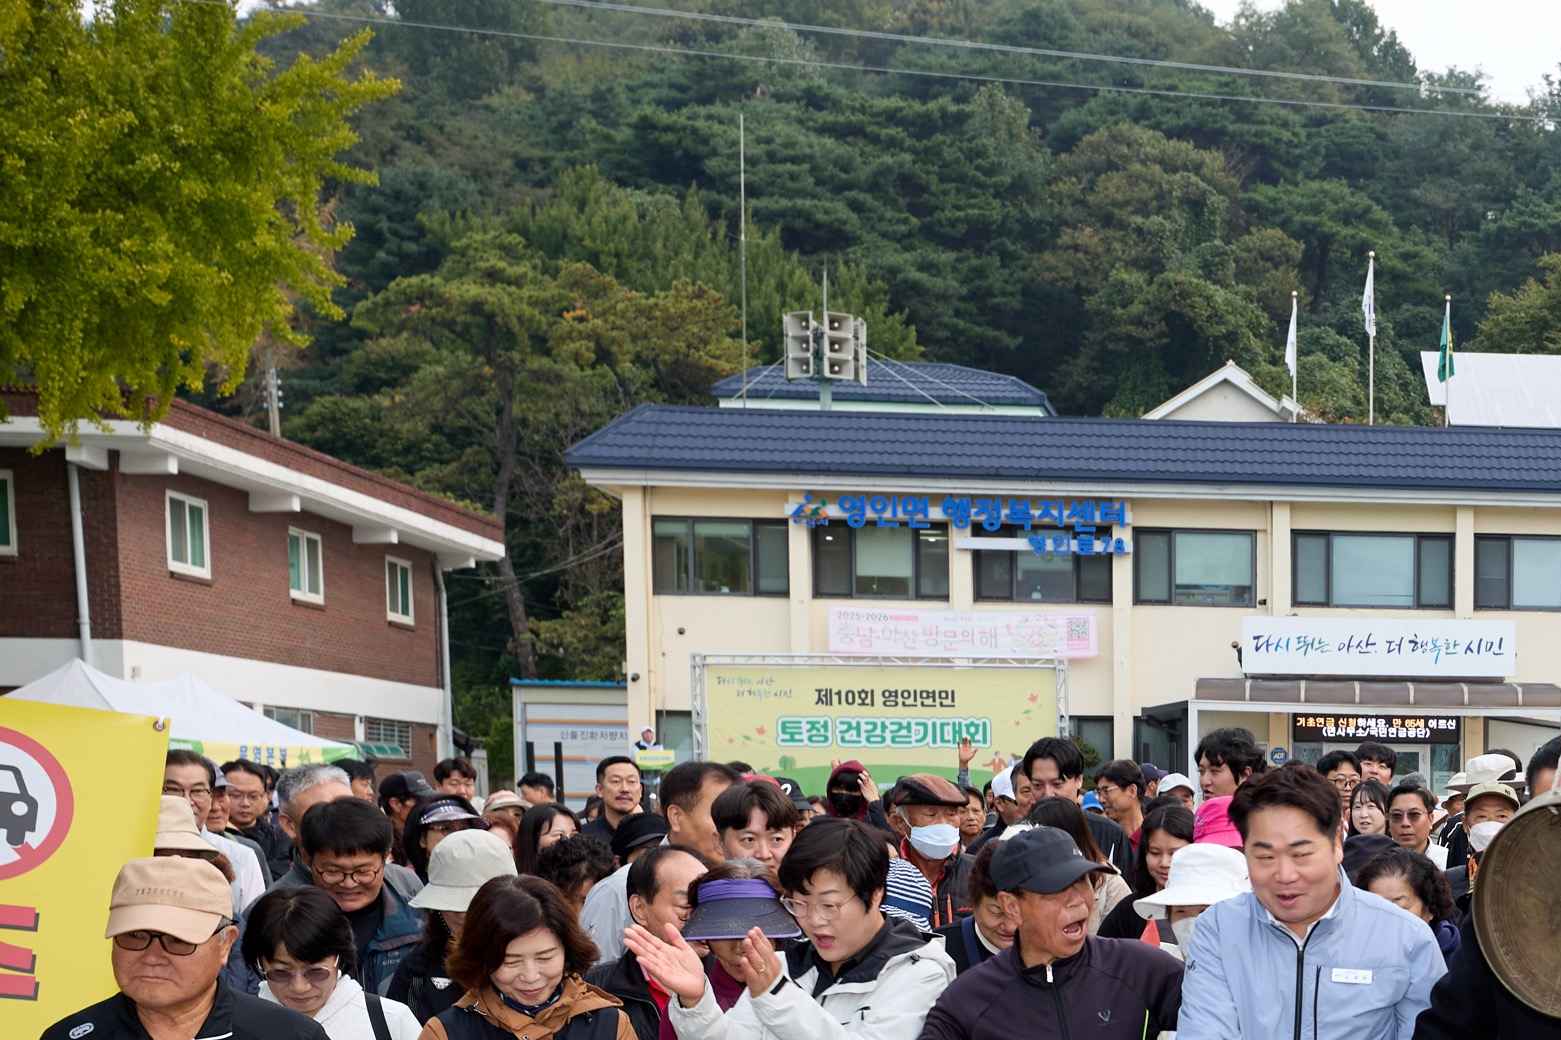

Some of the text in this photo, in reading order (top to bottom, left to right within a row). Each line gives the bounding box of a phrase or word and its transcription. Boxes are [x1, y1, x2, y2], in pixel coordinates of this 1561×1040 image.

[838, 495, 1126, 532] 영인면 행정복지센터
[1028, 535, 1125, 556] 영인로 78
[1252, 634, 1290, 653] 다시
[1295, 634, 1331, 656] 뛰는
[1386, 636, 1403, 655] 더
[1409, 632, 1459, 664] 행복한
[1464, 637, 1504, 656] 시민
[815, 688, 957, 709] 제10회 영인면민
[779, 717, 990, 747] 토정 건강걷기대회
[1296, 717, 1335, 728] 기초연금
[1392, 718, 1401, 728] 만
[1405, 718, 1424, 729] 65세
[1427, 718, 1457, 730] 어르신
